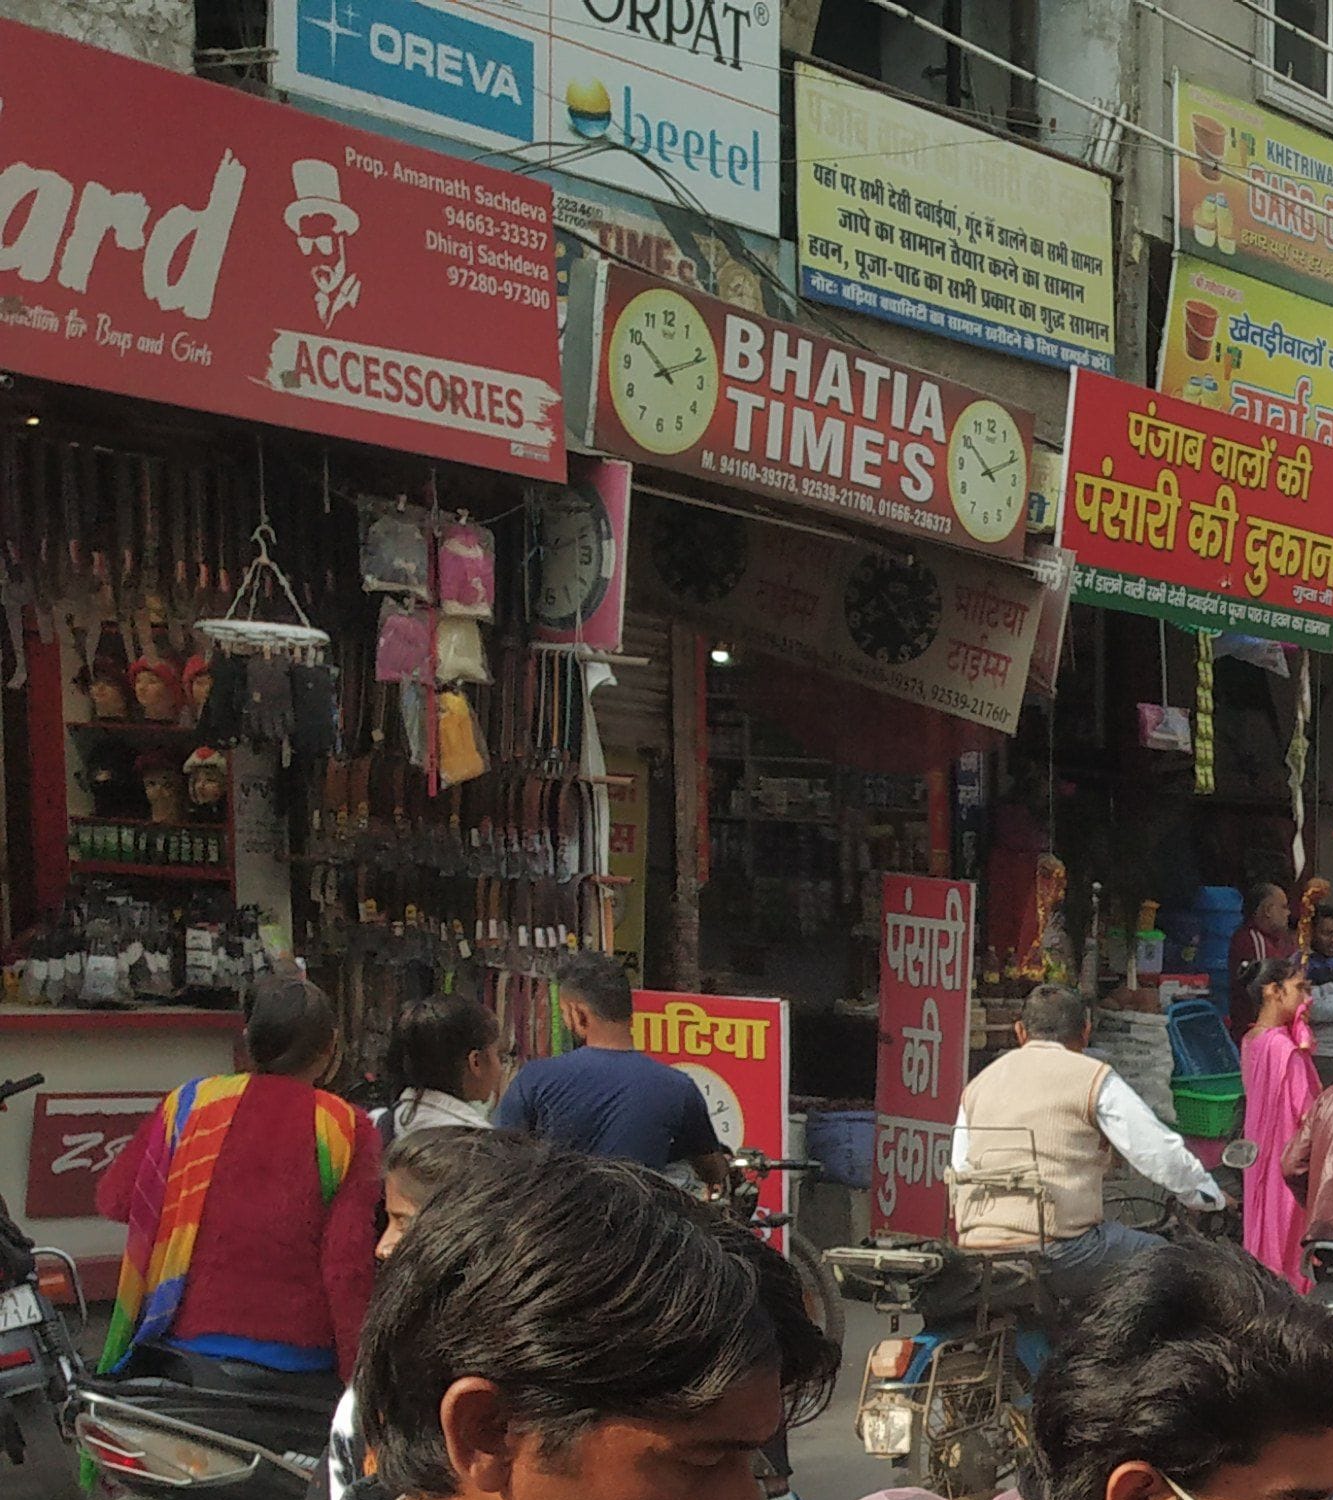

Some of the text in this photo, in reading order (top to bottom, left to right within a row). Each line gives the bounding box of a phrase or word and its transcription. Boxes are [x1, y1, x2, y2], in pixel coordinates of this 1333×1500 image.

[368, 24, 523, 105] OREVA
[345, 146, 388, 178] Prop.
[393, 160, 471, 200] Amarnath
[473, 184, 548, 223] Sachdeva
[623, 85, 760, 192] beetel
[425, 229, 549, 282] Dhiraj Sachdeva
[444, 205, 548, 251] 94663-33337
[838, 207, 1085, 304] जापे का सामान तैयार करने का सामान
[840, 173, 856, 197] पर
[860, 177, 884, 206] सभी
[888, 182, 911, 216] देसी
[997, 225, 1027, 255] डालने
[1030, 236, 1044, 257] का
[1047, 240, 1068, 268] सभी
[1071, 249, 1103, 277] सामान
[447, 266, 550, 310] 97280-97300
[924, 267, 943, 295] का
[947, 272, 977, 305] सभी
[981, 287, 1015, 318] प्रकार
[1018, 299, 1036, 322] का
[1069, 312, 1110, 342] सामान
[948, 312, 983, 338] सामान
[295, 340, 525, 429] ACCESSORIES
[723, 314, 946, 444] BHATIA
[702, 450, 716, 471] M.
[726, 386, 936, 502] TIME'S
[1127, 400, 1314, 501] पंजाब वालों की
[1074, 456, 1182, 551] पंसारी
[1187, 483, 1239, 565] की
[886, 886, 966, 991] पंसारी
[902, 997, 942, 1098] की
